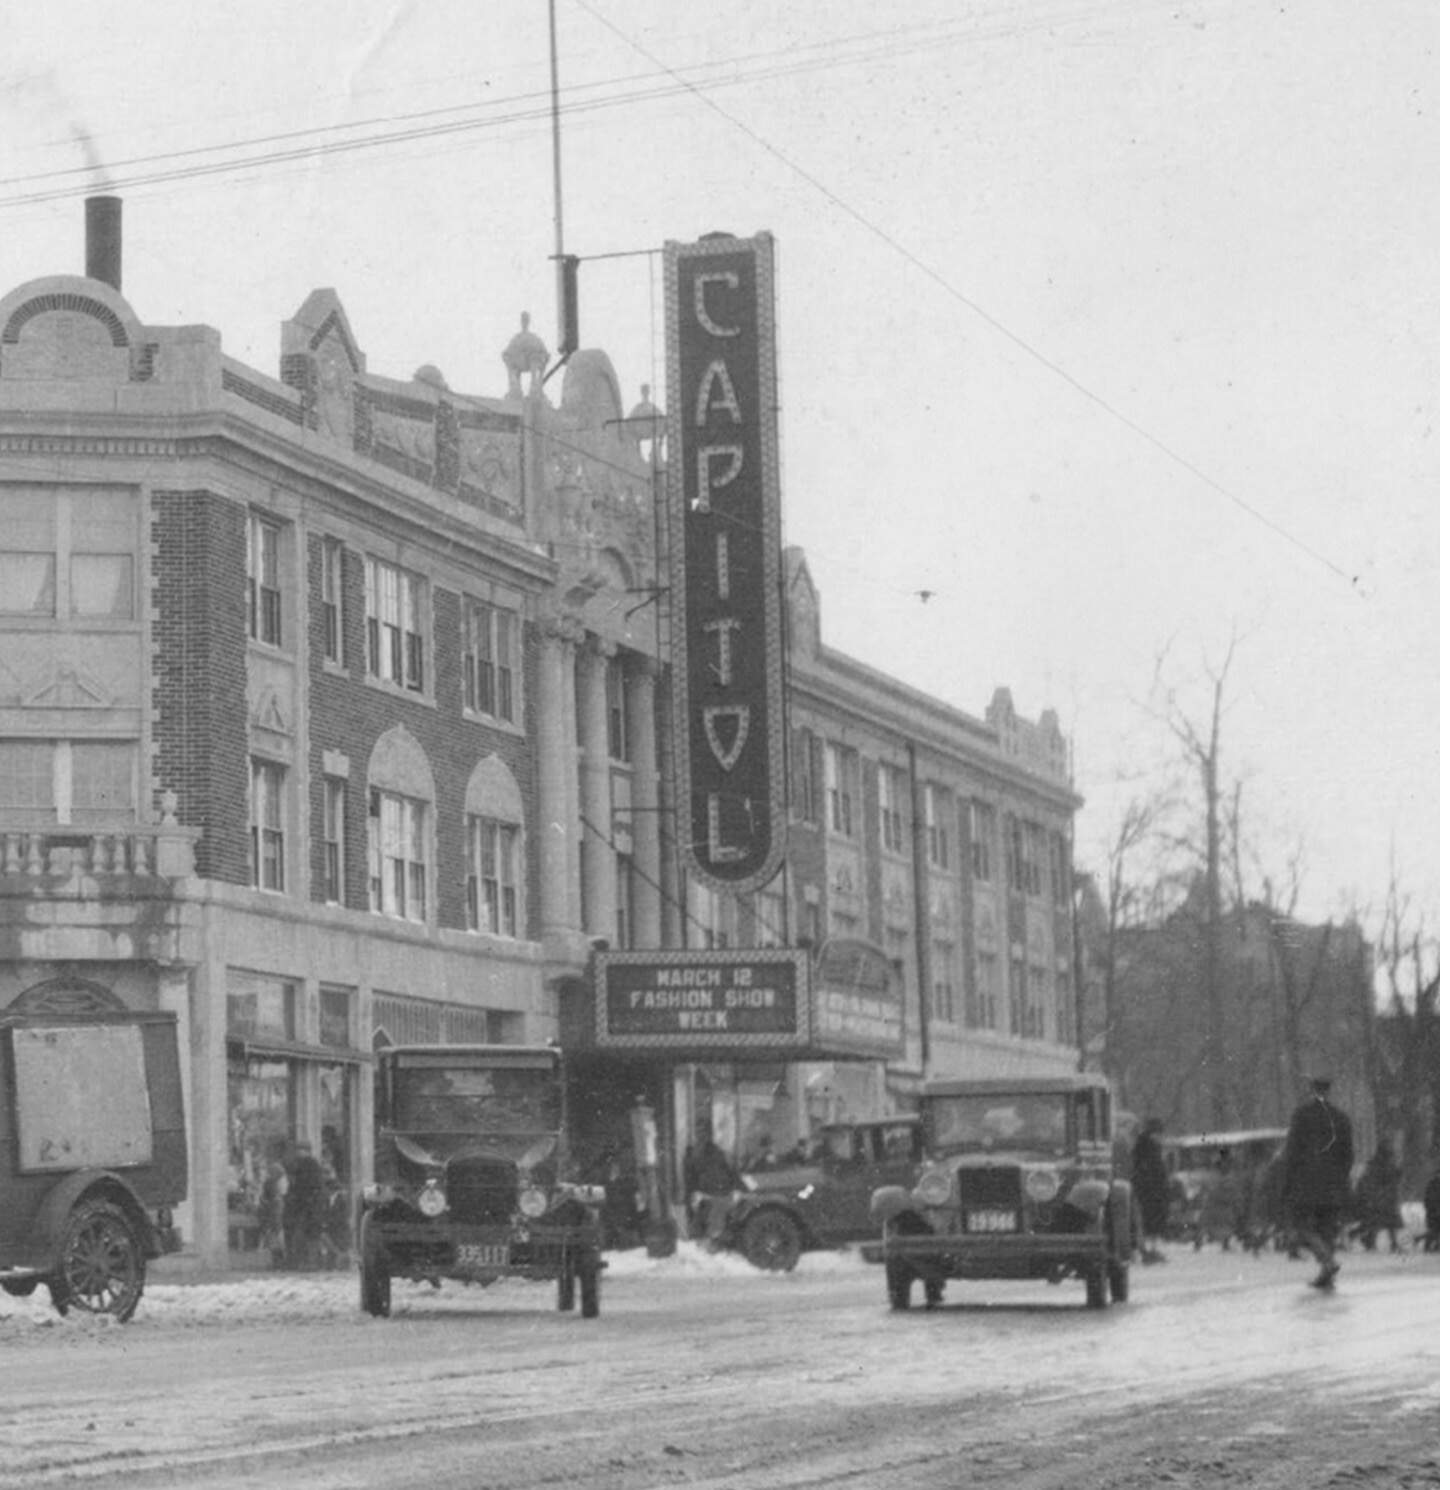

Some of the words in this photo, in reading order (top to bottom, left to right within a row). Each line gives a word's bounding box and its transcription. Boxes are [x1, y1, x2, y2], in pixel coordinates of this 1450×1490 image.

[693, 271, 750, 863] CAPITOL
[657, 968, 721, 986] MARCH
[733, 967, 752, 986] 12
[630, 990, 713, 1008] FASHION
[725, 989, 775, 1008] SHOW
[678, 1010, 728, 1029] WEEK
